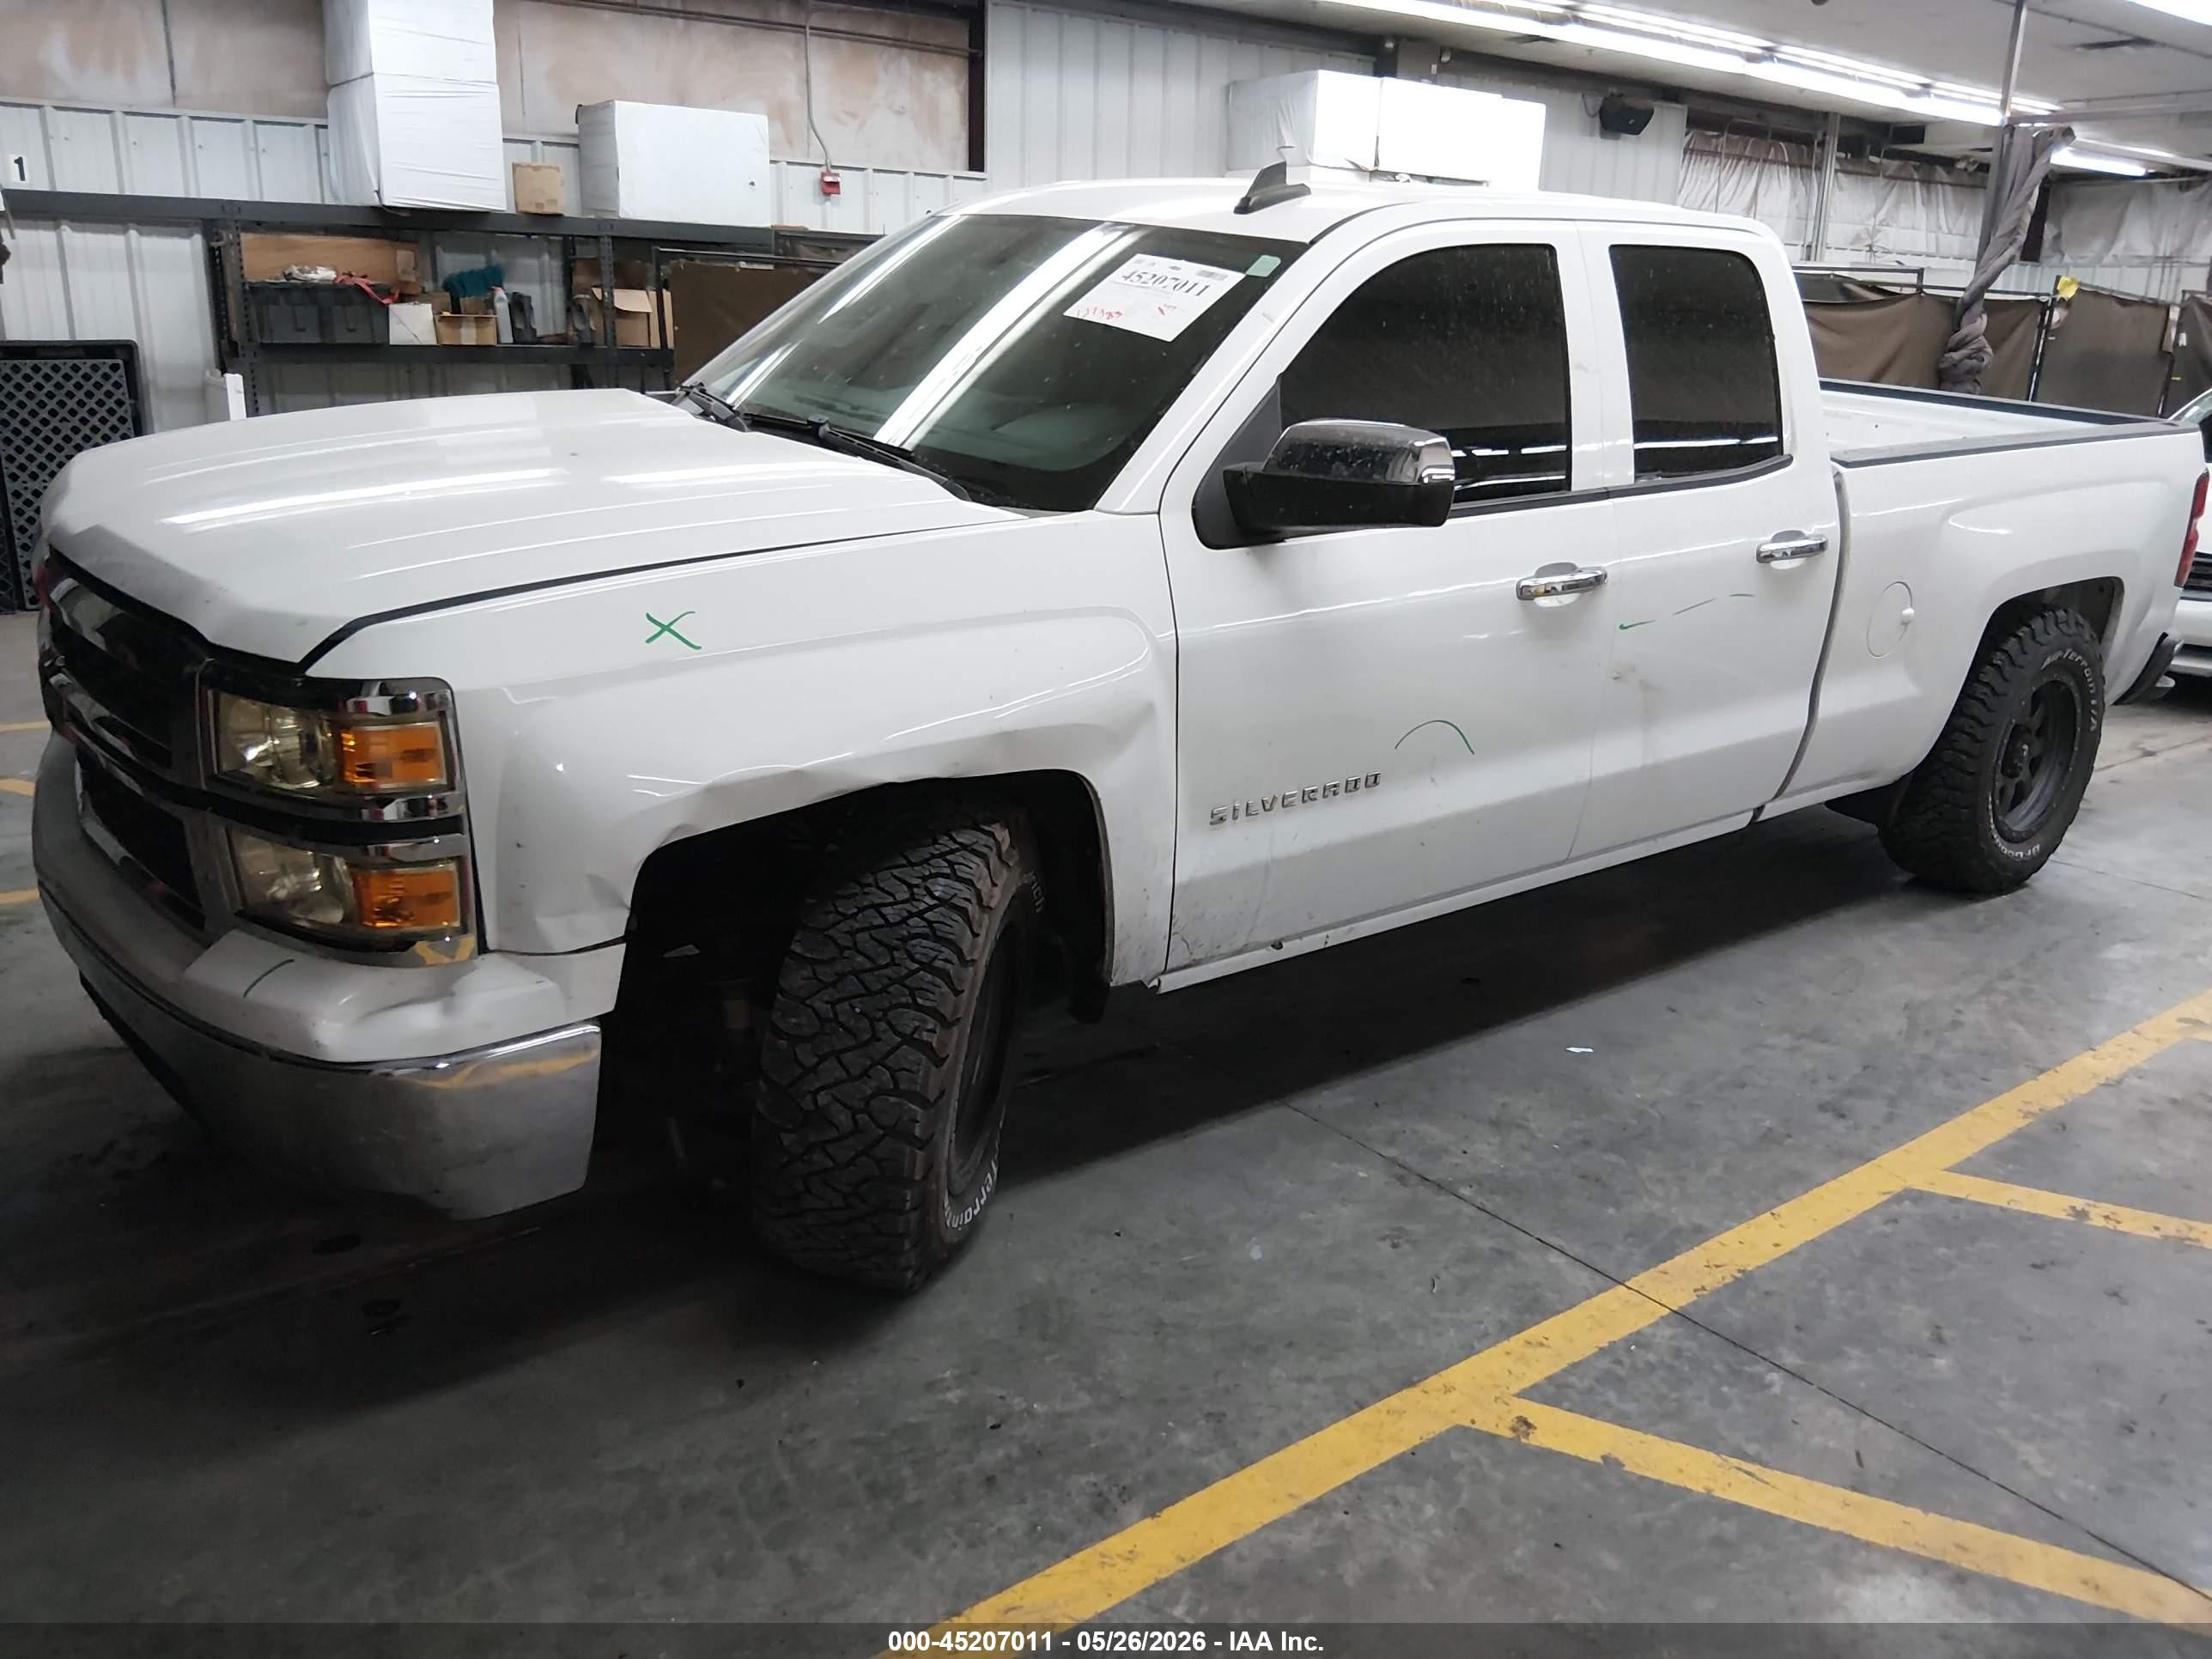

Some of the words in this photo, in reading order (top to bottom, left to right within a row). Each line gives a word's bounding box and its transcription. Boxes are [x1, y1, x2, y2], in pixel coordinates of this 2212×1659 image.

[14, 156, 26, 181] 1
[1121, 270, 1211, 297] 45207011
[1209, 771, 1382, 826] SILVERADO
